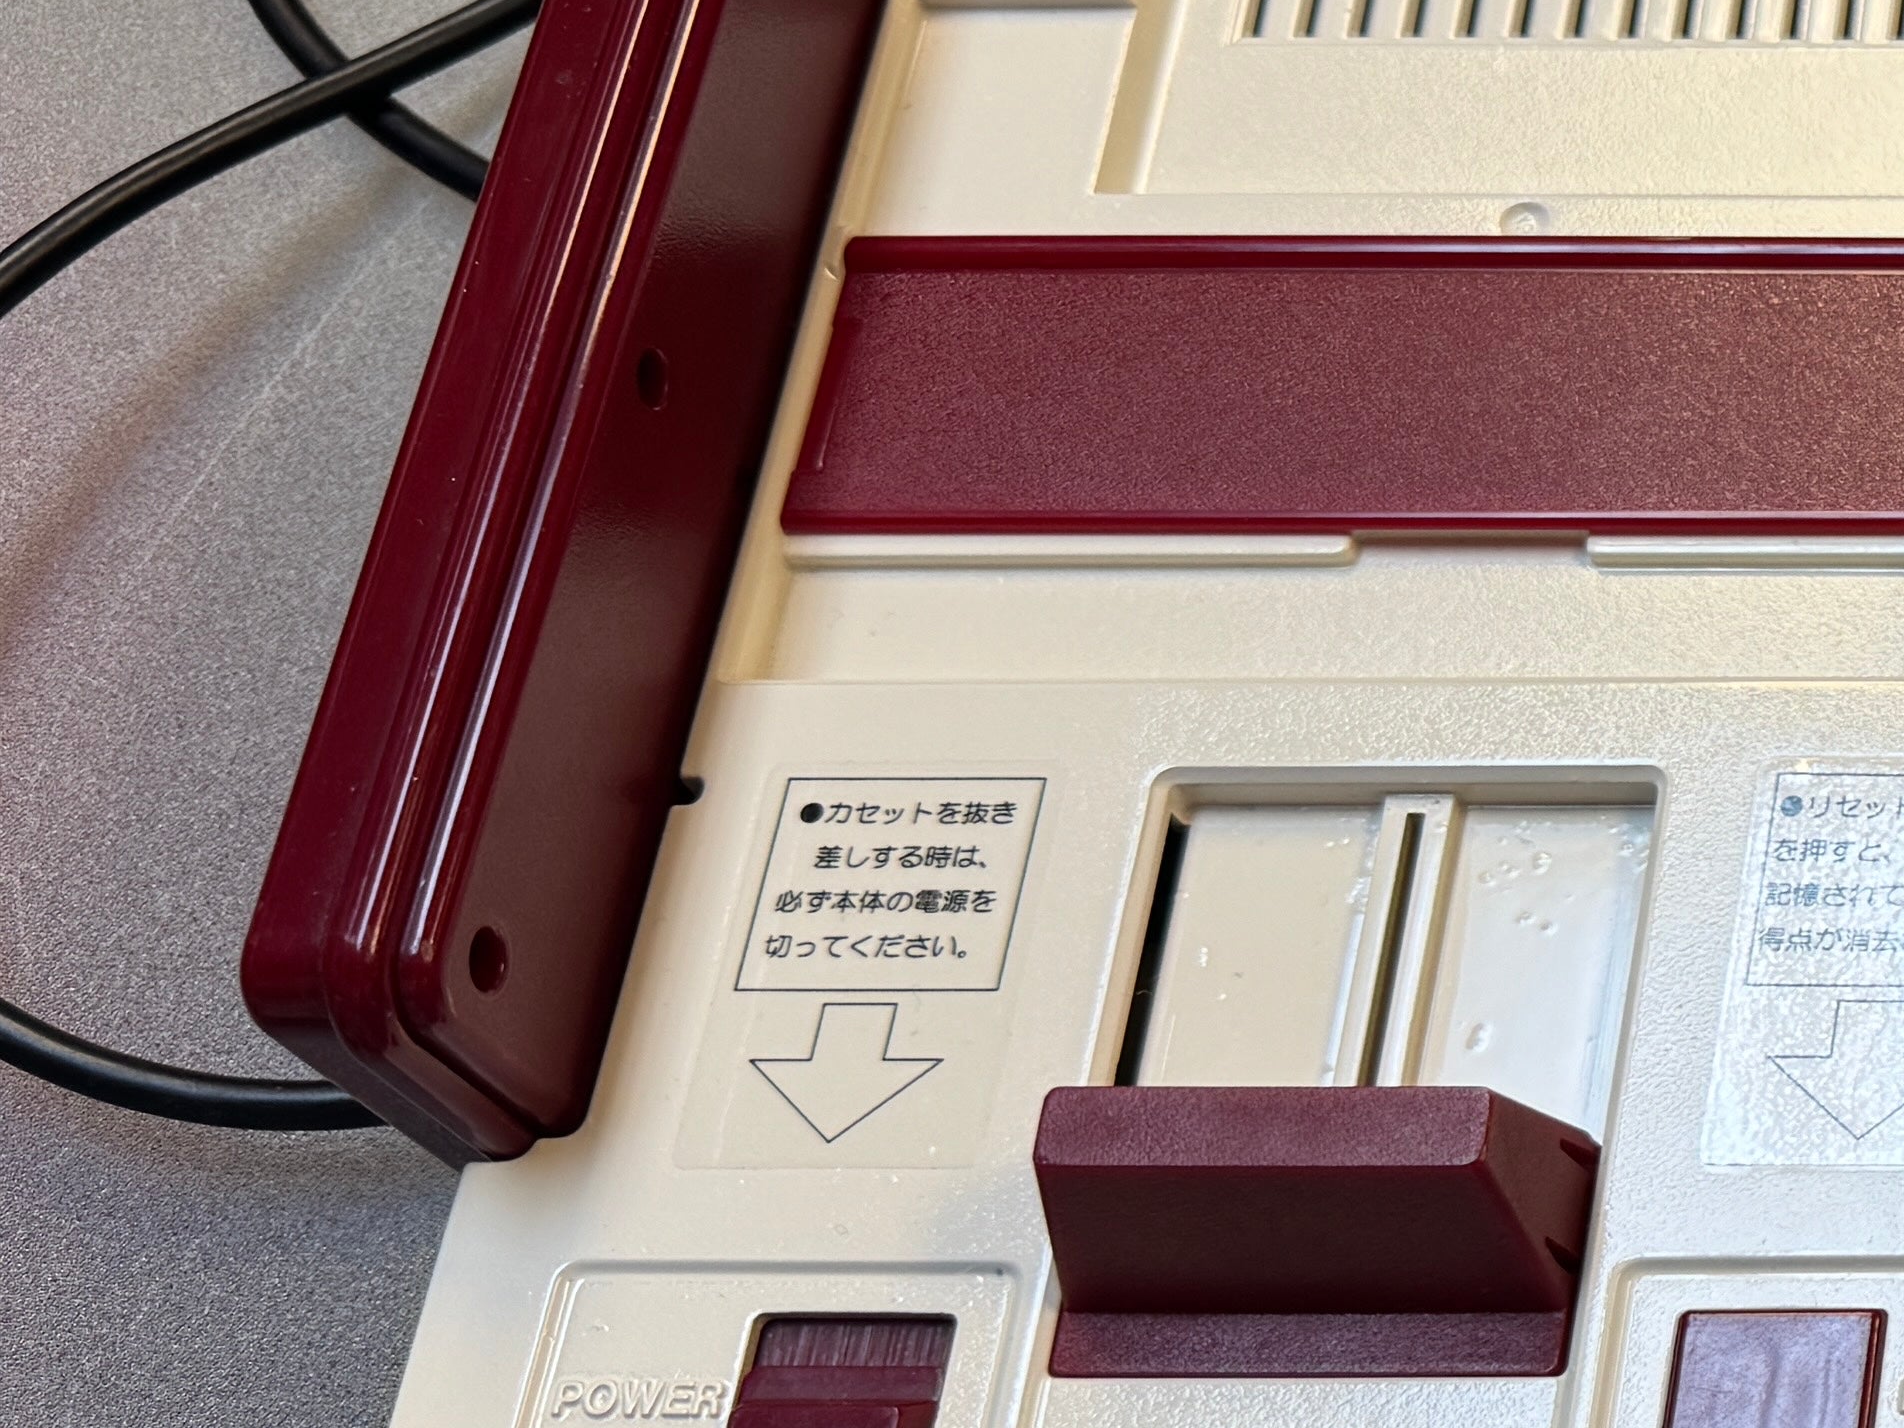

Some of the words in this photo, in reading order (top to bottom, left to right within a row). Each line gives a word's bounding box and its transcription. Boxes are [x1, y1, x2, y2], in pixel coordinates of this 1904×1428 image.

[812, 844, 990, 871] 差しする時は、
[774, 888, 999, 914] 必ず本体の電源を
[763, 934, 970, 961] 切ってください。
[549, 1377, 731, 1421] POWER
